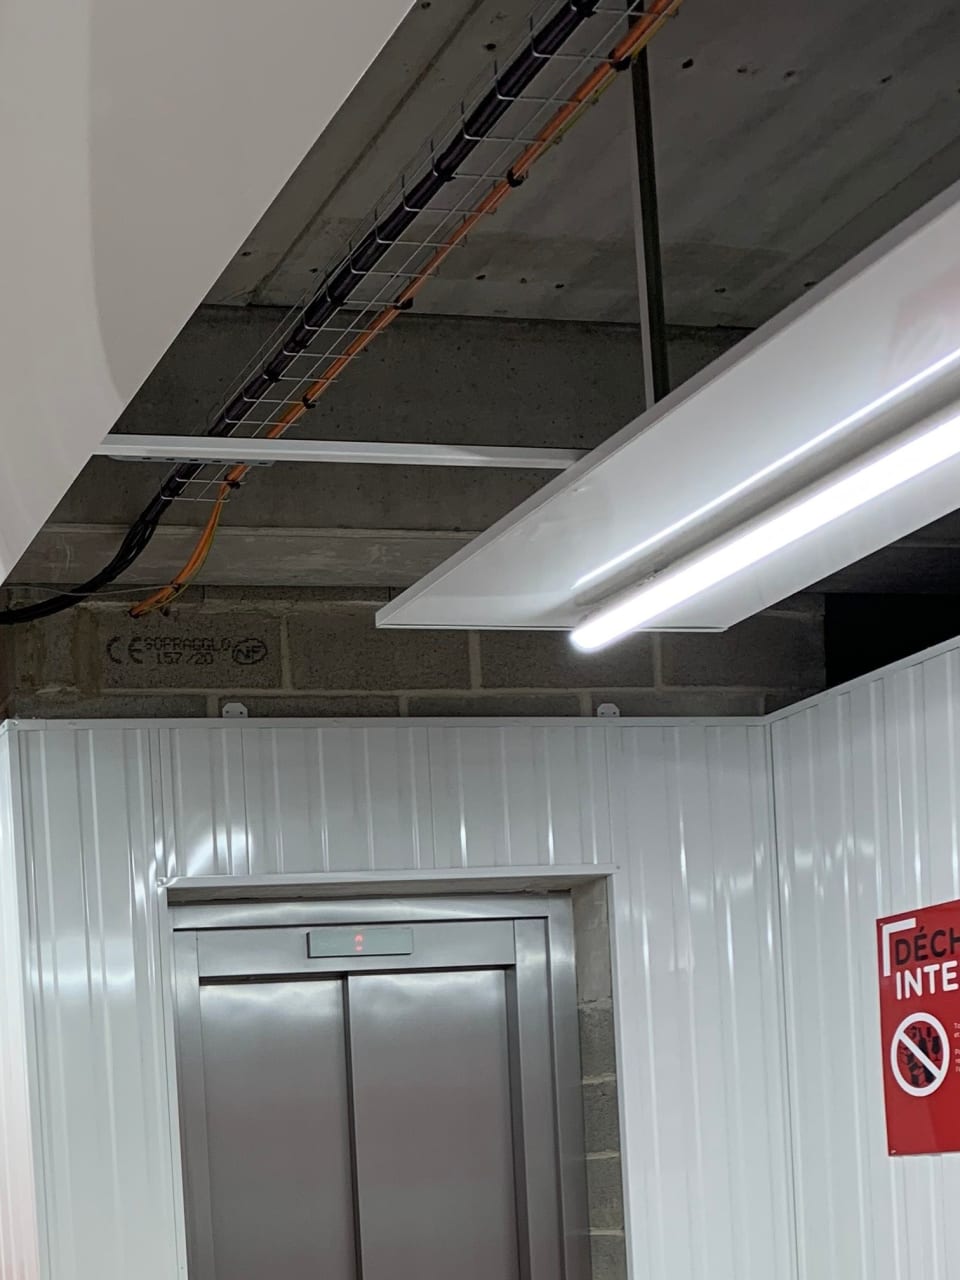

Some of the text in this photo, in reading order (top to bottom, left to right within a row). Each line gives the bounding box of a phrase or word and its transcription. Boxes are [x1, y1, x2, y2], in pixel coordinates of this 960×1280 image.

[107, 637, 143, 664] CE
[235, 643, 263, 661] NF
[896, 960, 959, 1000] INTE
